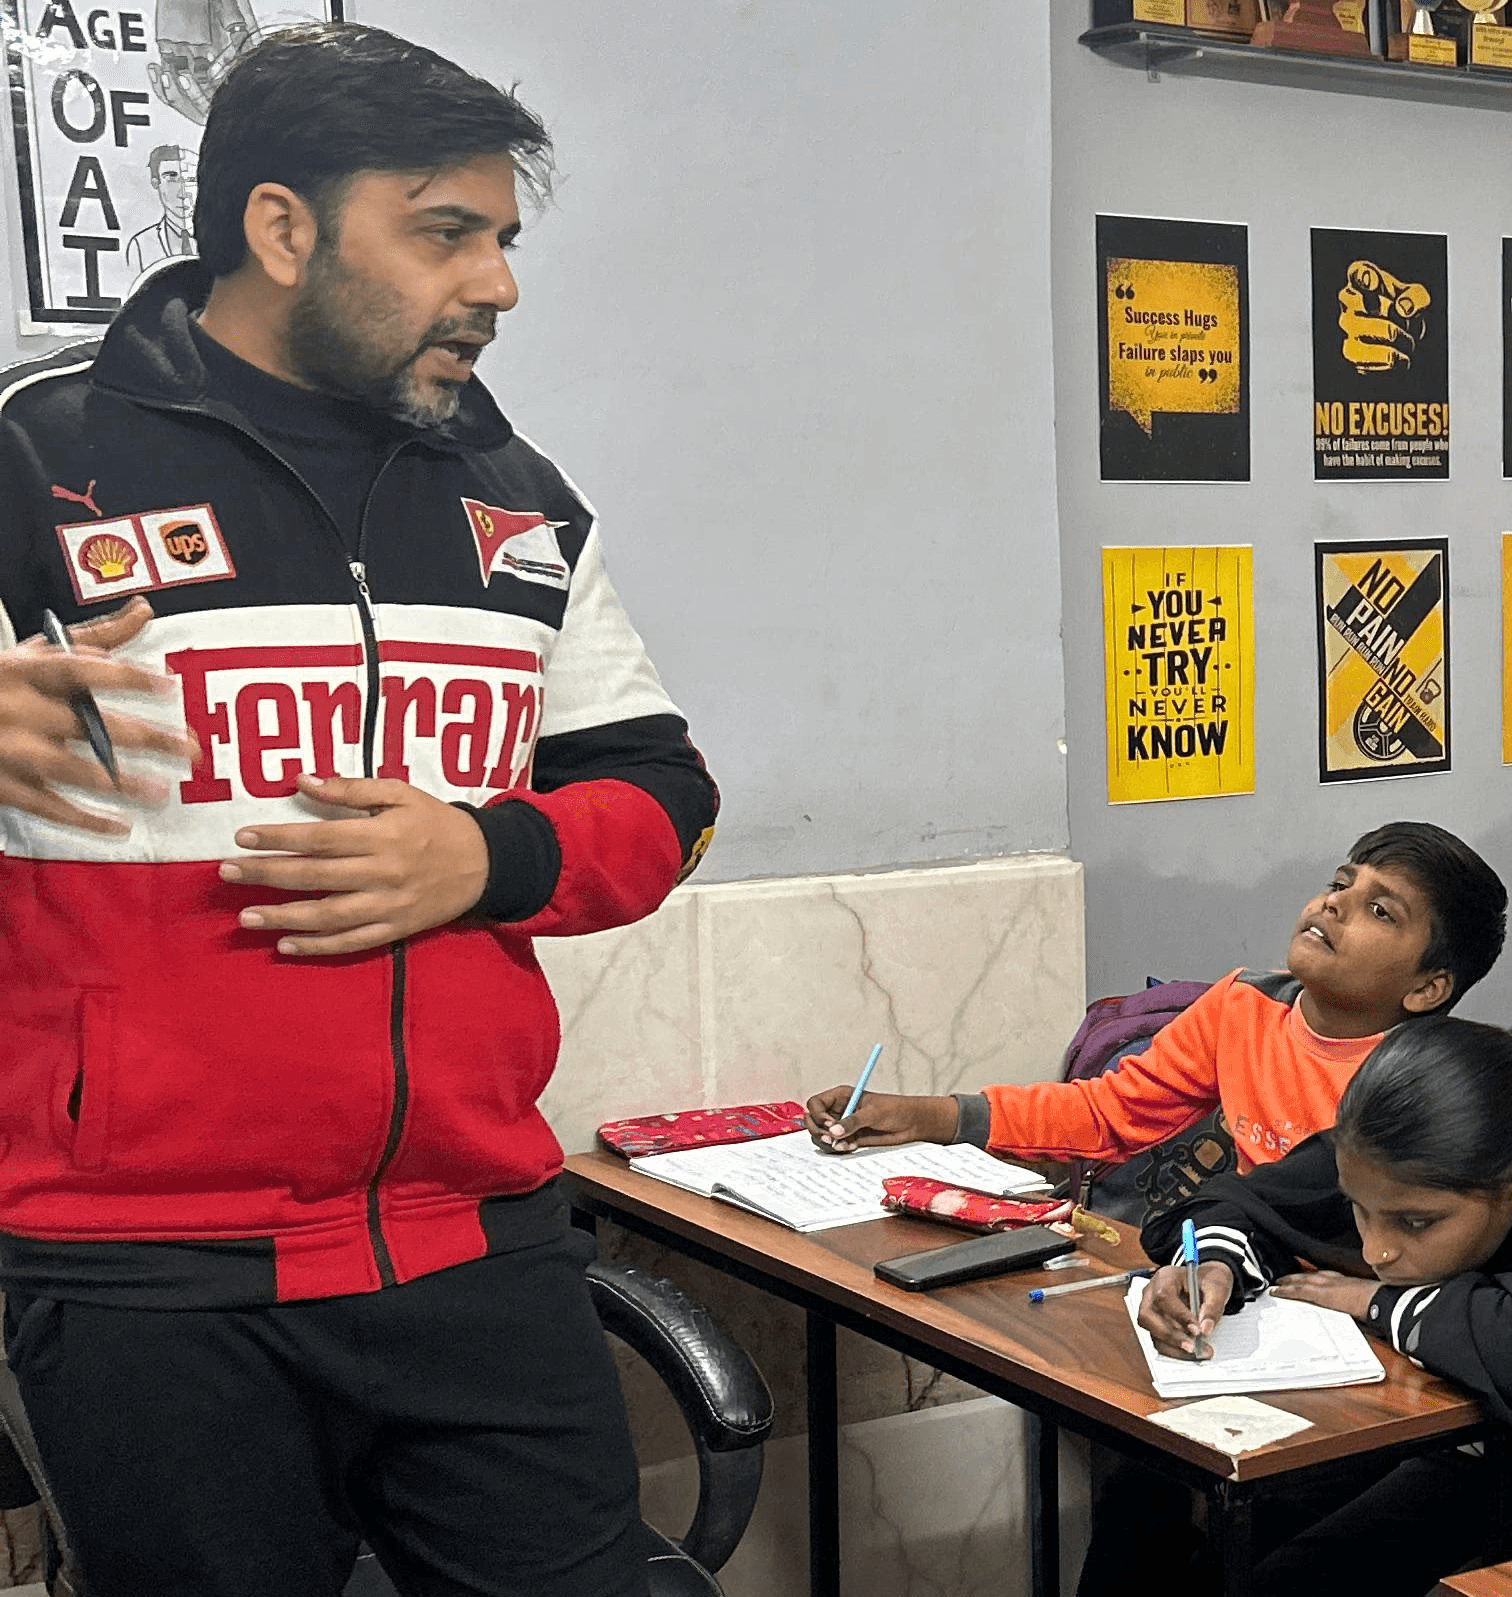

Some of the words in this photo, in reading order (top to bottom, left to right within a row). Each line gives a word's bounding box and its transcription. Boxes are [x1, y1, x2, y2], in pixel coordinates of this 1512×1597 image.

[36, 0, 147, 51] AGE
[51, 69, 149, 147] OF
[1125, 307, 1180, 326] Success
[1184, 309, 1218, 331] Hugs
[1118, 342, 1166, 361] Failure
[1170, 345, 1205, 365] slaps
[1209, 350, 1232, 365] you
[1145, 366, 1155, 377] in
[1157, 364, 1193, 383] public
[1315, 401, 1345, 436] NO
[1348, 401, 1448, 436] EXCUSES!
[1165, 572, 1187, 588] IF
[1357, 558, 1406, 615] NO
[1147, 589, 1203, 619] YOU
[1128, 617, 1227, 651] NEVER
[1346, 598, 1405, 667] PAIN
[1142, 646, 1213, 686] TRY
[1383, 656, 1417, 698] NO
[1129, 695, 1227, 717] NEVER
[1151, 687, 1207, 697] YOU'LL
[1364, 681, 1411, 734] GAIN
[165, 640, 544, 804] Ferrar
[1127, 720, 1229, 761] KNOW
